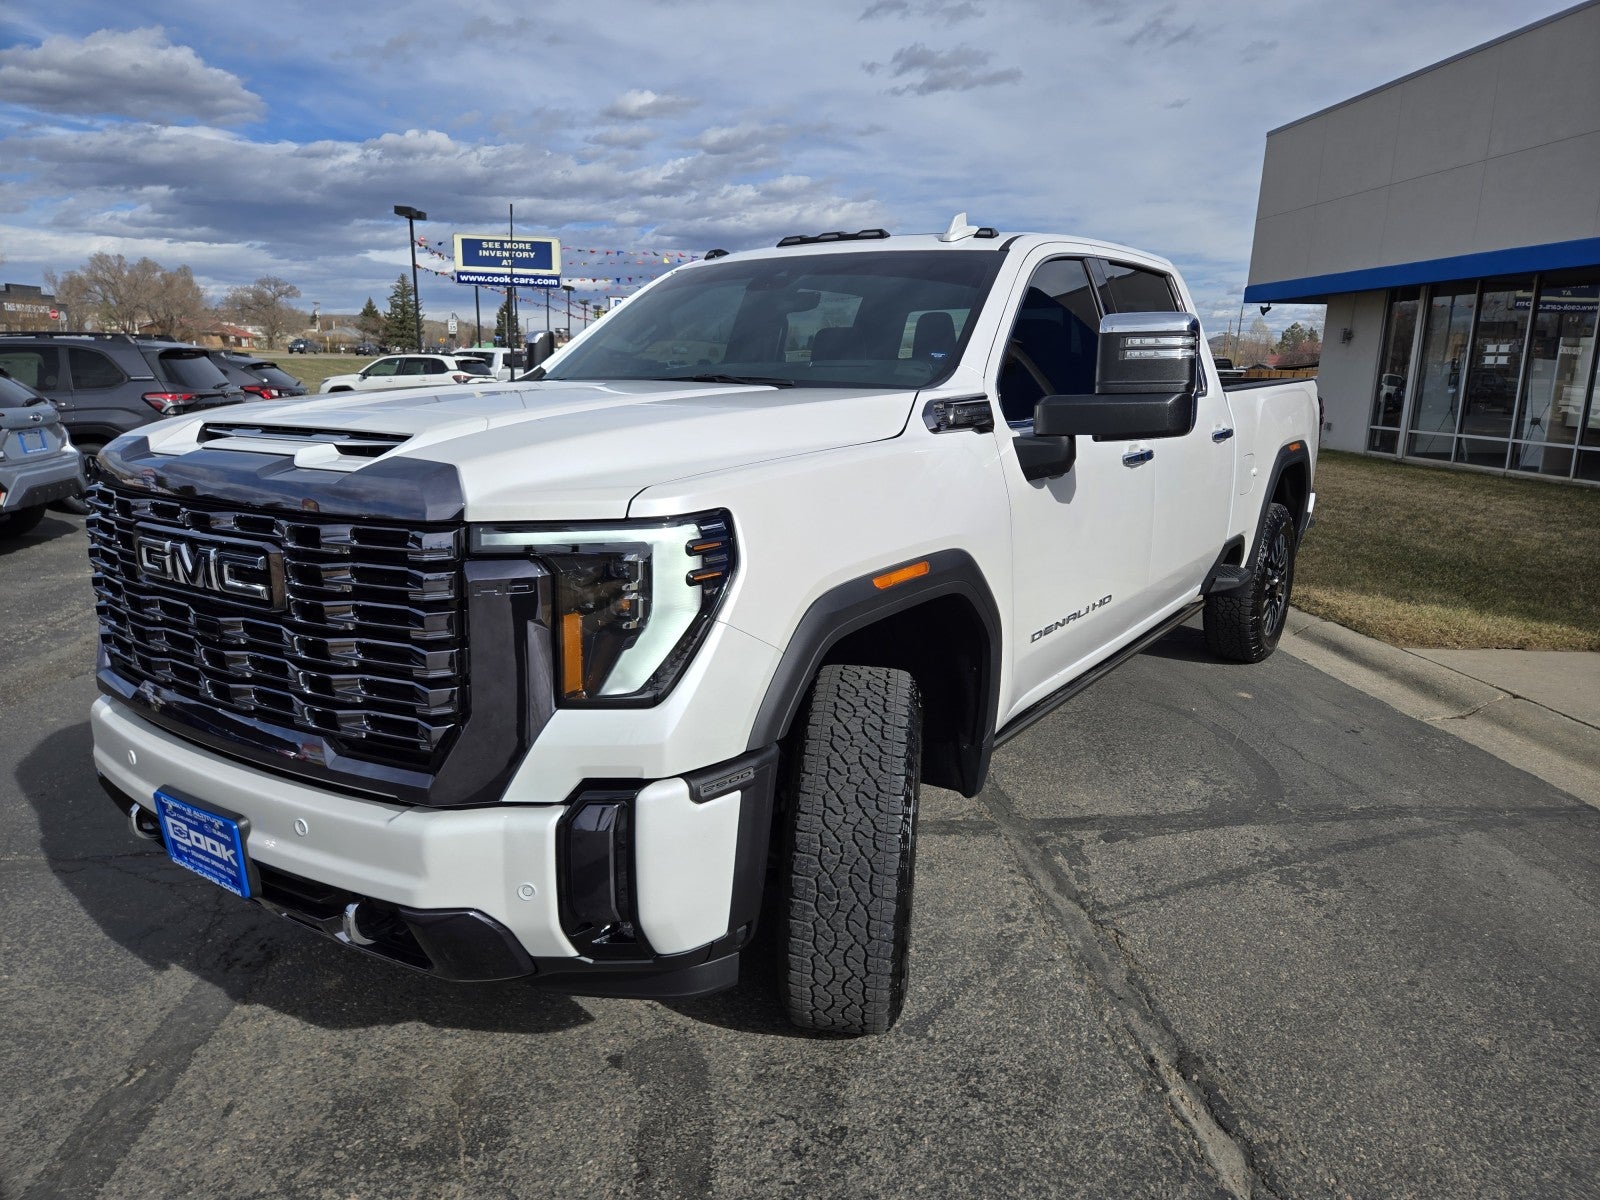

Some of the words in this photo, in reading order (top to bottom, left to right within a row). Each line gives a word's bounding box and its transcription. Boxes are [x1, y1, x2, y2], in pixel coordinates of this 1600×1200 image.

[482, 241, 501, 249] SEE
[503, 242, 532, 250] MORE
[478, 250, 536, 259] INVENTORY
[460, 274, 558, 286] www.cookcars.com
[3, 302, 16, 311] THE
[137, 536, 268, 600] GMC
[1030, 605, 1090, 643] DENALI
[1091, 594, 1112, 611] HD
